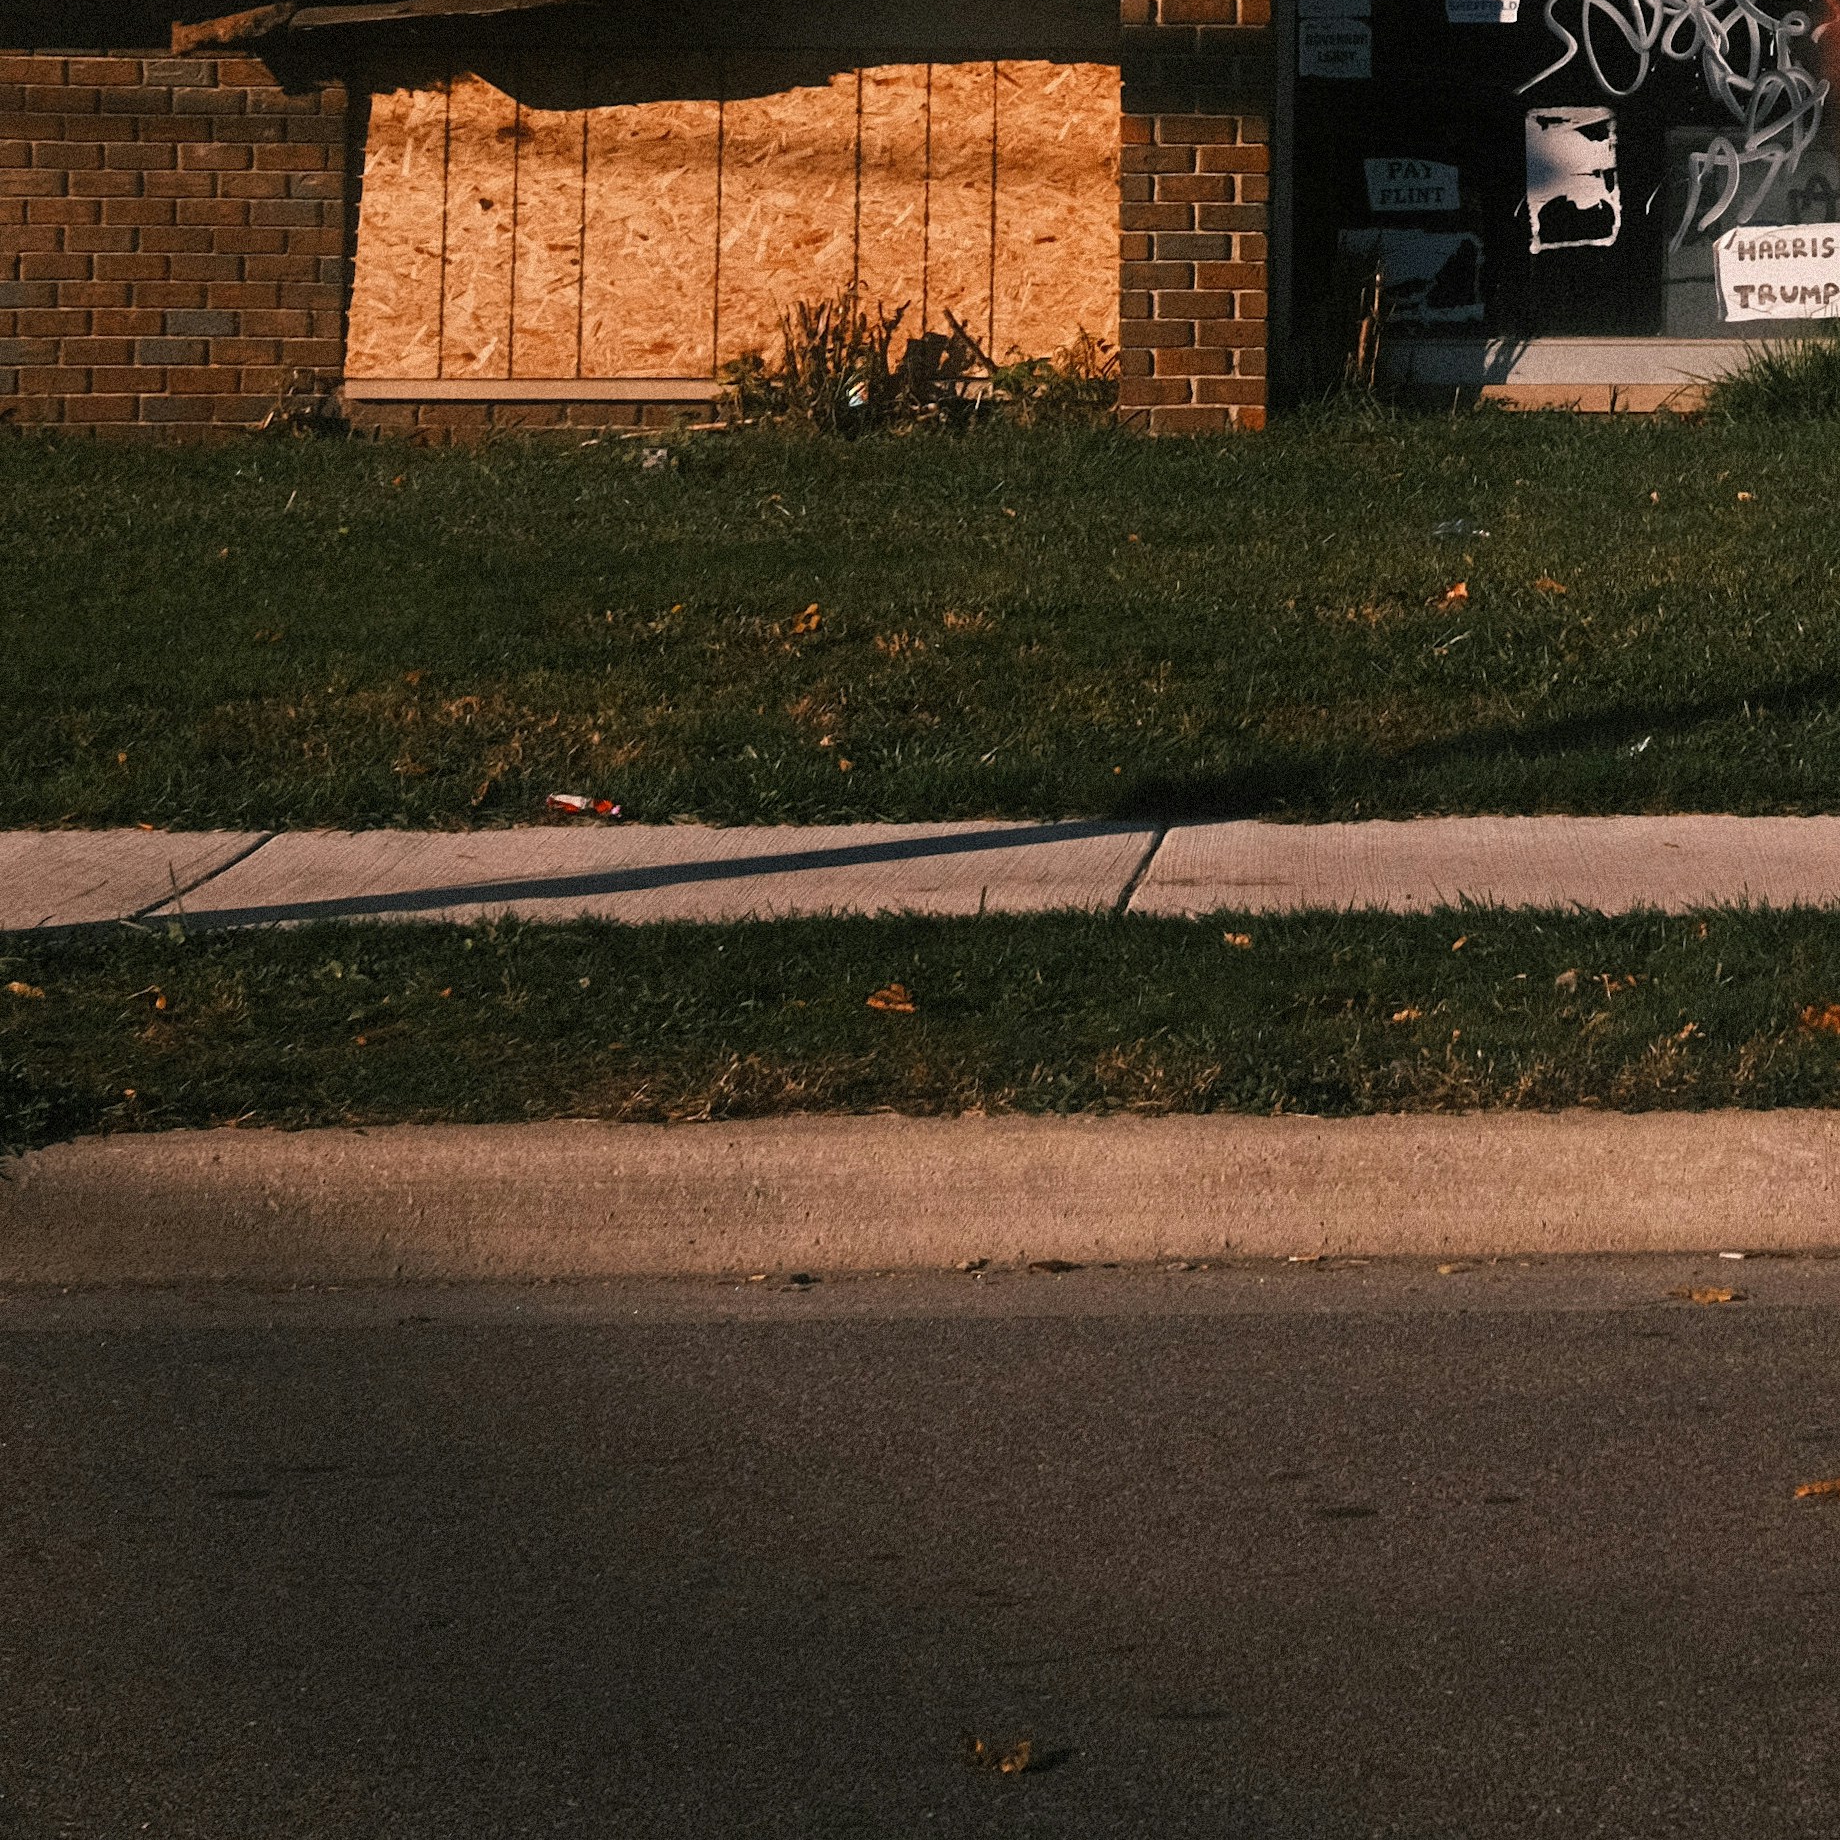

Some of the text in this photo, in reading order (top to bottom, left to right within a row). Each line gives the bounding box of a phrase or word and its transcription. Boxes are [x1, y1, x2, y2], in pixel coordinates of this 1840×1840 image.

[1388, 161, 1433, 179] PAY
[1379, 187, 1445, 205] FLINT
[1736, 237, 1836, 261] HARRIS
[1733, 282, 1840, 308] TRUMP
